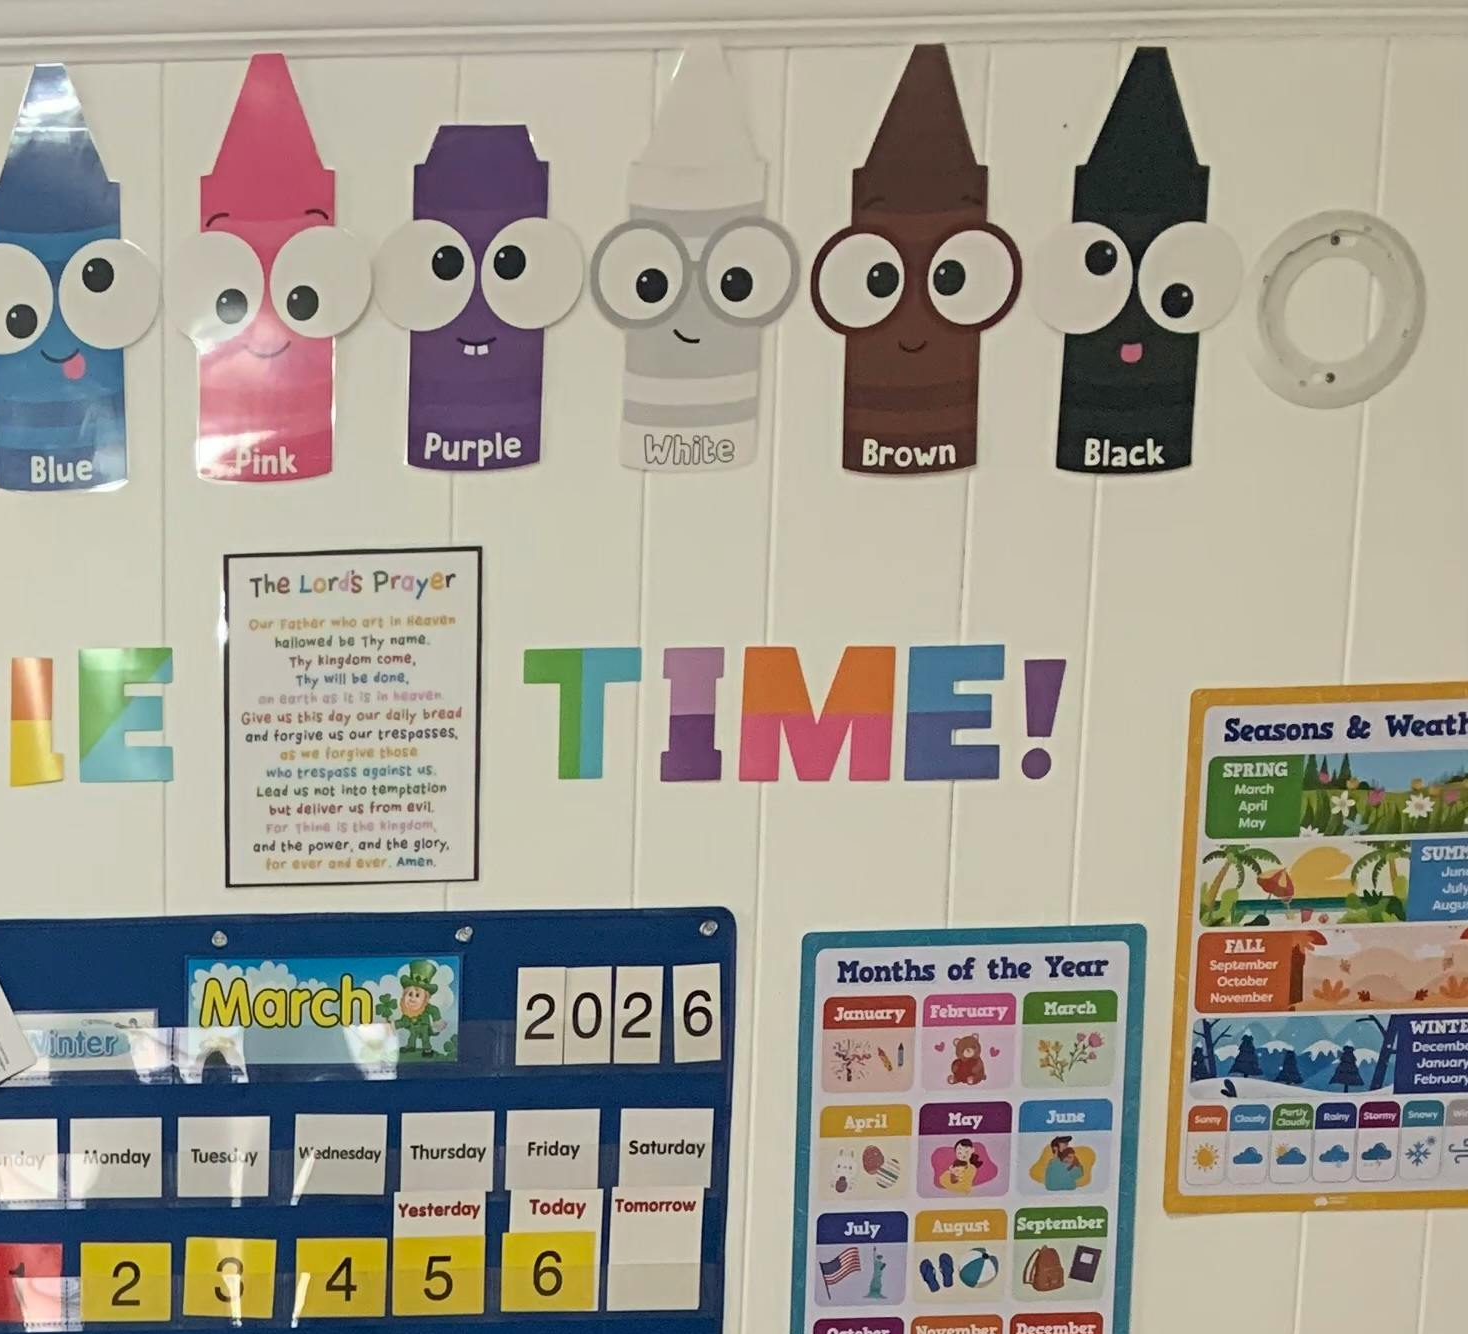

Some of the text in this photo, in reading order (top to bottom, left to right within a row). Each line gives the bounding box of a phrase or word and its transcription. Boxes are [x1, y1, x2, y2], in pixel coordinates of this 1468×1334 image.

[233, 446, 297, 476] Pink
[424, 432, 521, 464] Purple
[643, 433, 735, 466] White
[862, 439, 957, 466] Brown
[1084, 437, 1165, 467] Black
[30, 456, 93, 484] Blue
[250, 570, 456, 600] The Lord's Prayer
[289, 653, 416, 671] Thy kingdom come,
[523, 644, 1066, 782] TIME!
[1224, 718, 1333, 742] Seasons
[1347, 717, 1370, 739] &
[1223, 762, 1288, 778] SPRING
[269, 801, 434, 816] but deliver us from evil.
[1225, 938, 1266, 954] FALL
[837, 956, 1110, 983] Months of the Year
[198, 973, 374, 1029] March
[833, 1006, 906, 1024] January
[523, 990, 714, 1041] 2026
[948, 1112, 983, 1129] May
[84, 1137, 706, 1167] Monday Tuesday Thursday Friday Saturday
[398, 1197, 696, 1220] Yesterday Today Tomorrow
[111, 1249, 563, 1306] 2 4 5 6
